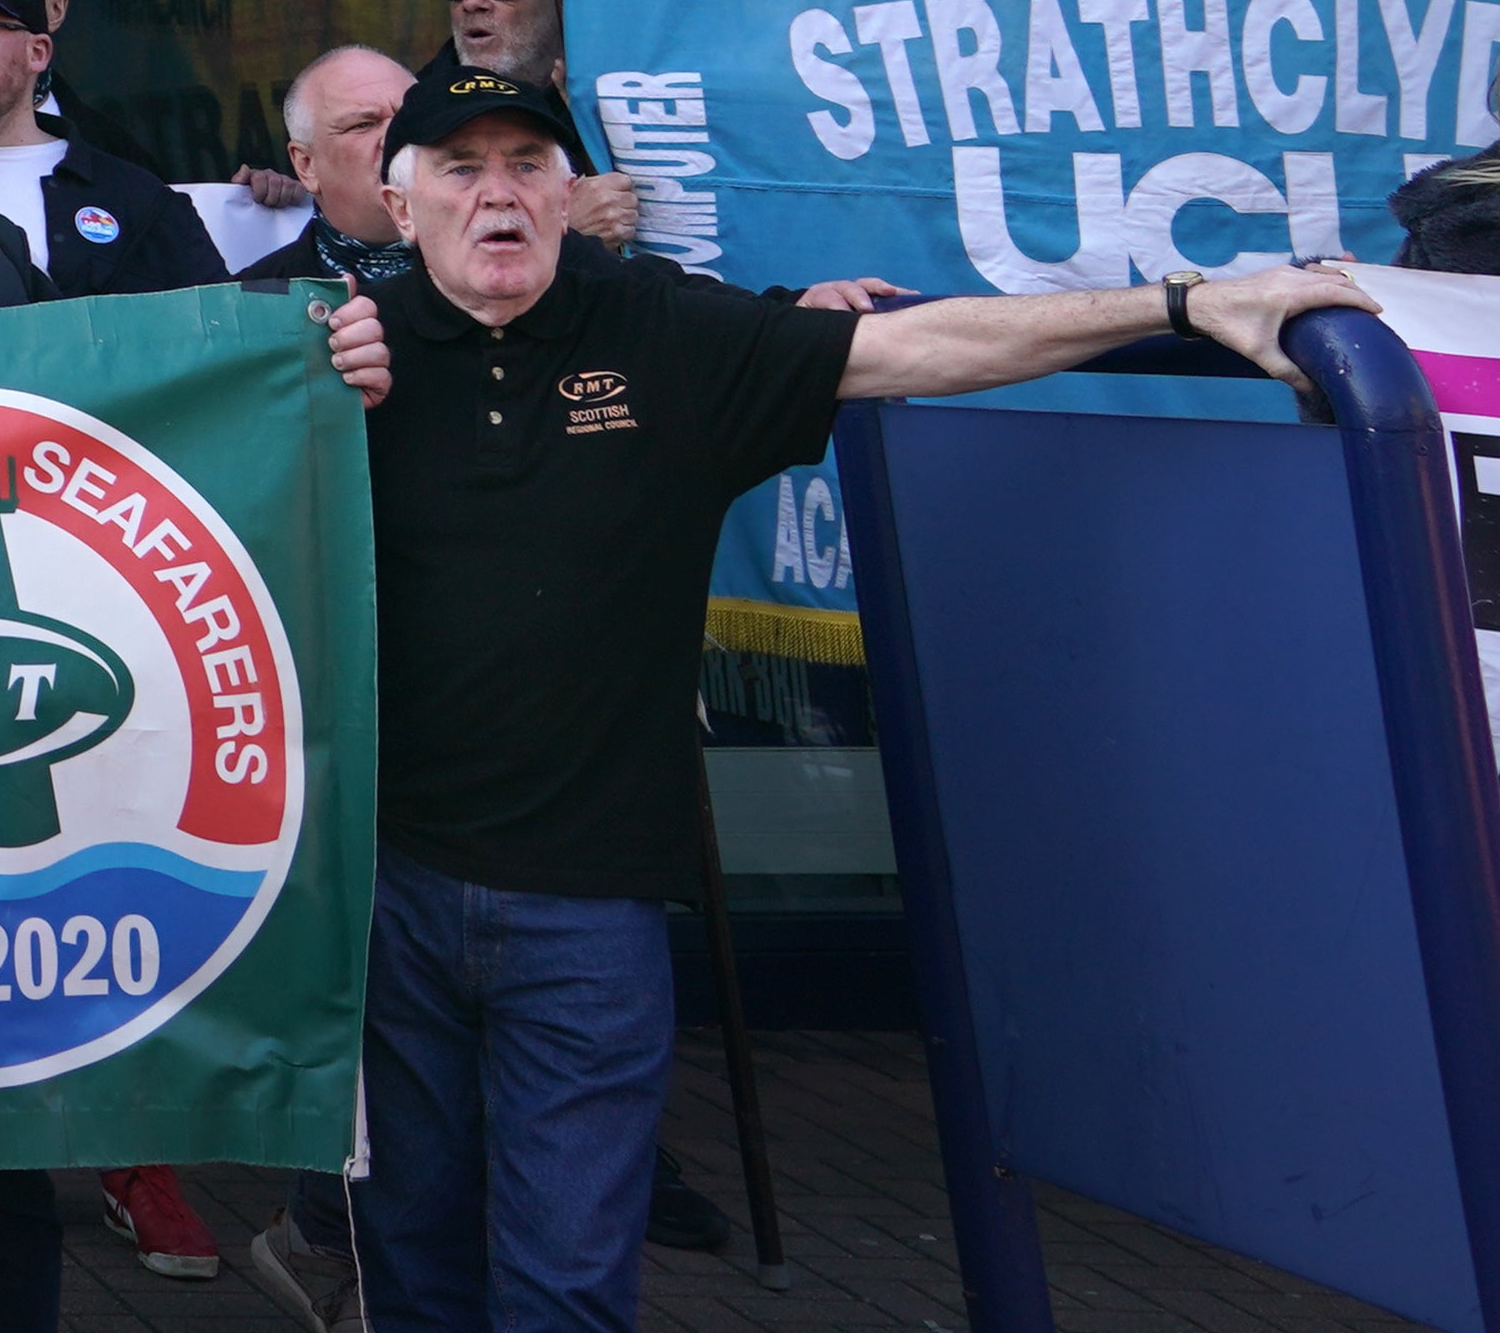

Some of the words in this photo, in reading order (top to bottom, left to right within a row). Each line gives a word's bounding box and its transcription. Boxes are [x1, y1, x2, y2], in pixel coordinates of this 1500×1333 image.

[596, 71, 724, 283] OMPUTER
[569, 404, 630, 424] SCOTTISH
[573, 378, 614, 394] RMT
[23, 440, 269, 786] SEAFARERS
